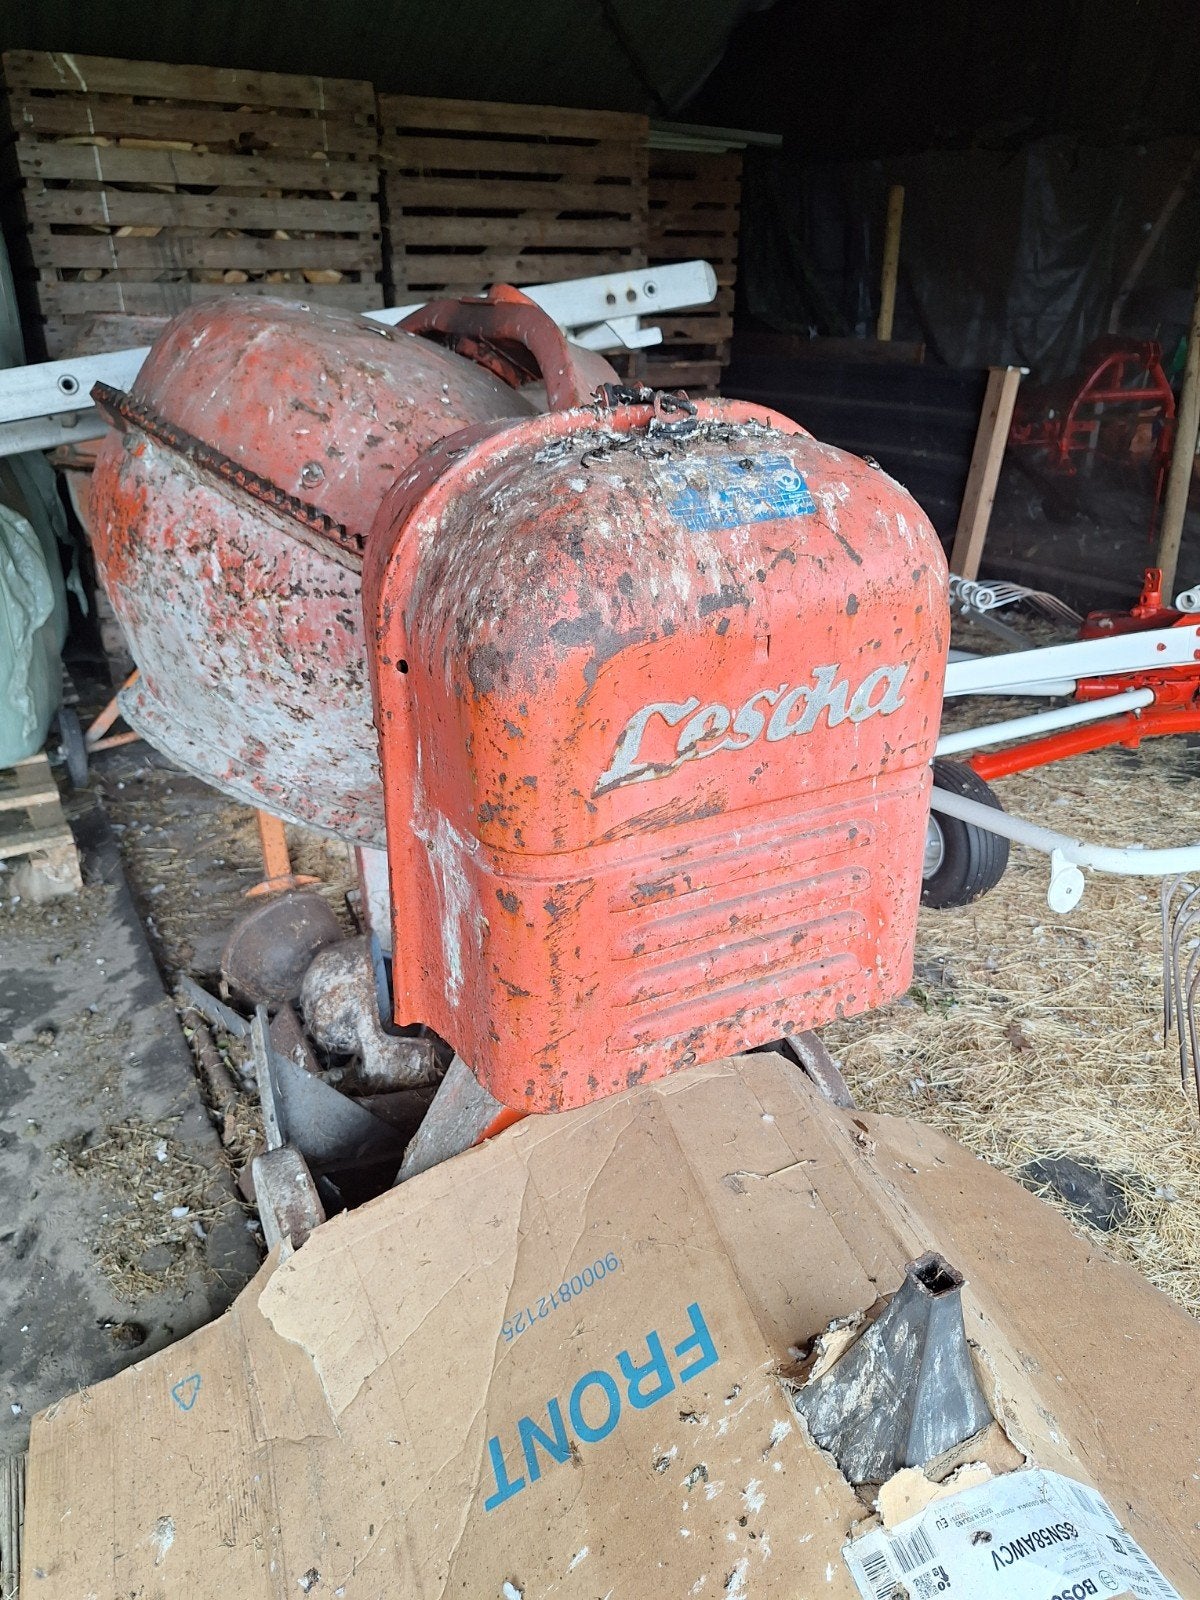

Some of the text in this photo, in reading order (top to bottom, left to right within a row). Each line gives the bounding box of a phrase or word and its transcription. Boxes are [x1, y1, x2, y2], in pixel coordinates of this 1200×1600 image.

[591, 663, 909, 800] Lescha
[501, 1252, 619, 1342] 9000812125
[484, 1302, 719, 1512] FRONT
[935, 1517, 949, 1531] EU
